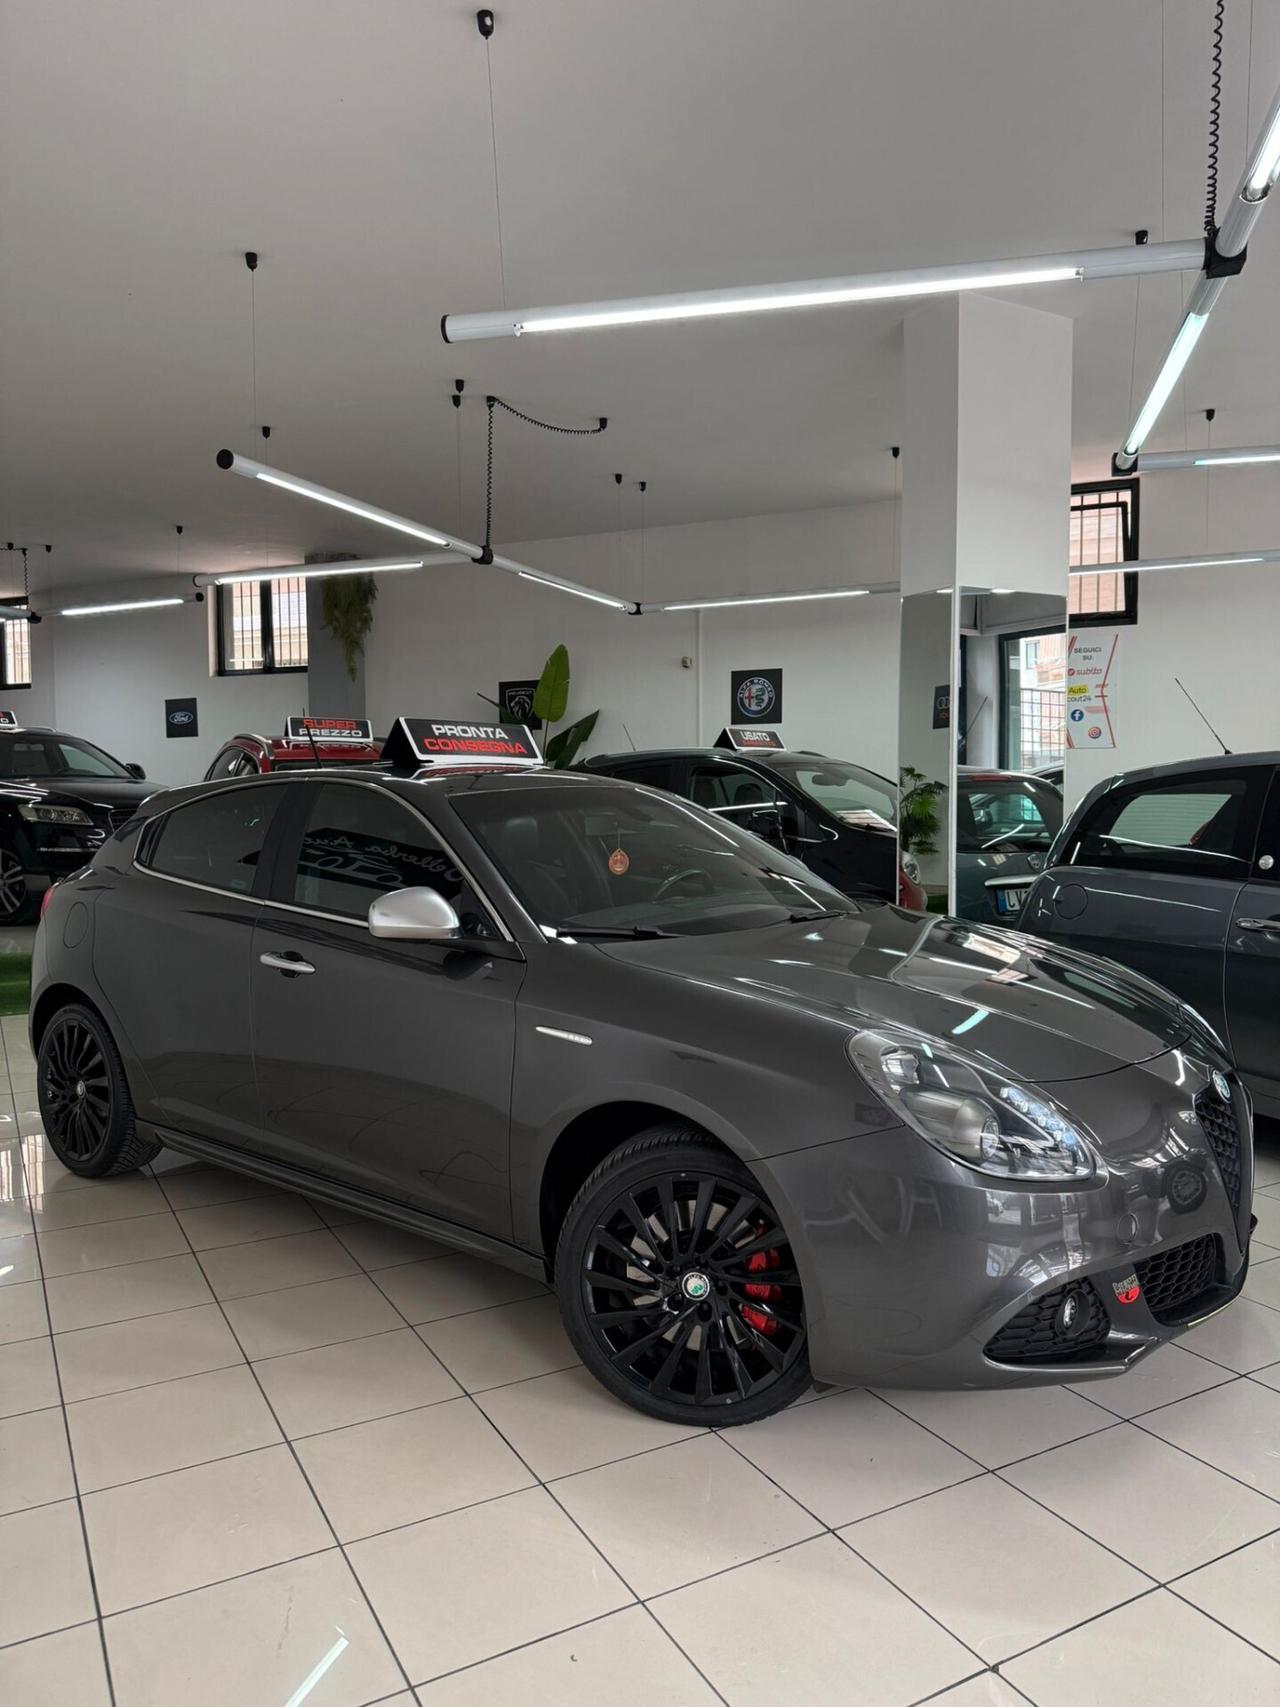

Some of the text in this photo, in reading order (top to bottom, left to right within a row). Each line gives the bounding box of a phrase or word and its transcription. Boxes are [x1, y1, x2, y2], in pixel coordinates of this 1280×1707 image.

[303, 719, 358, 729] SUPER
[299, 728, 363, 737] PREZZO
[431, 724, 508, 739] PRONTA
[740, 731, 771, 741] USATO
[423, 738, 529, 754] CONSEGNA
